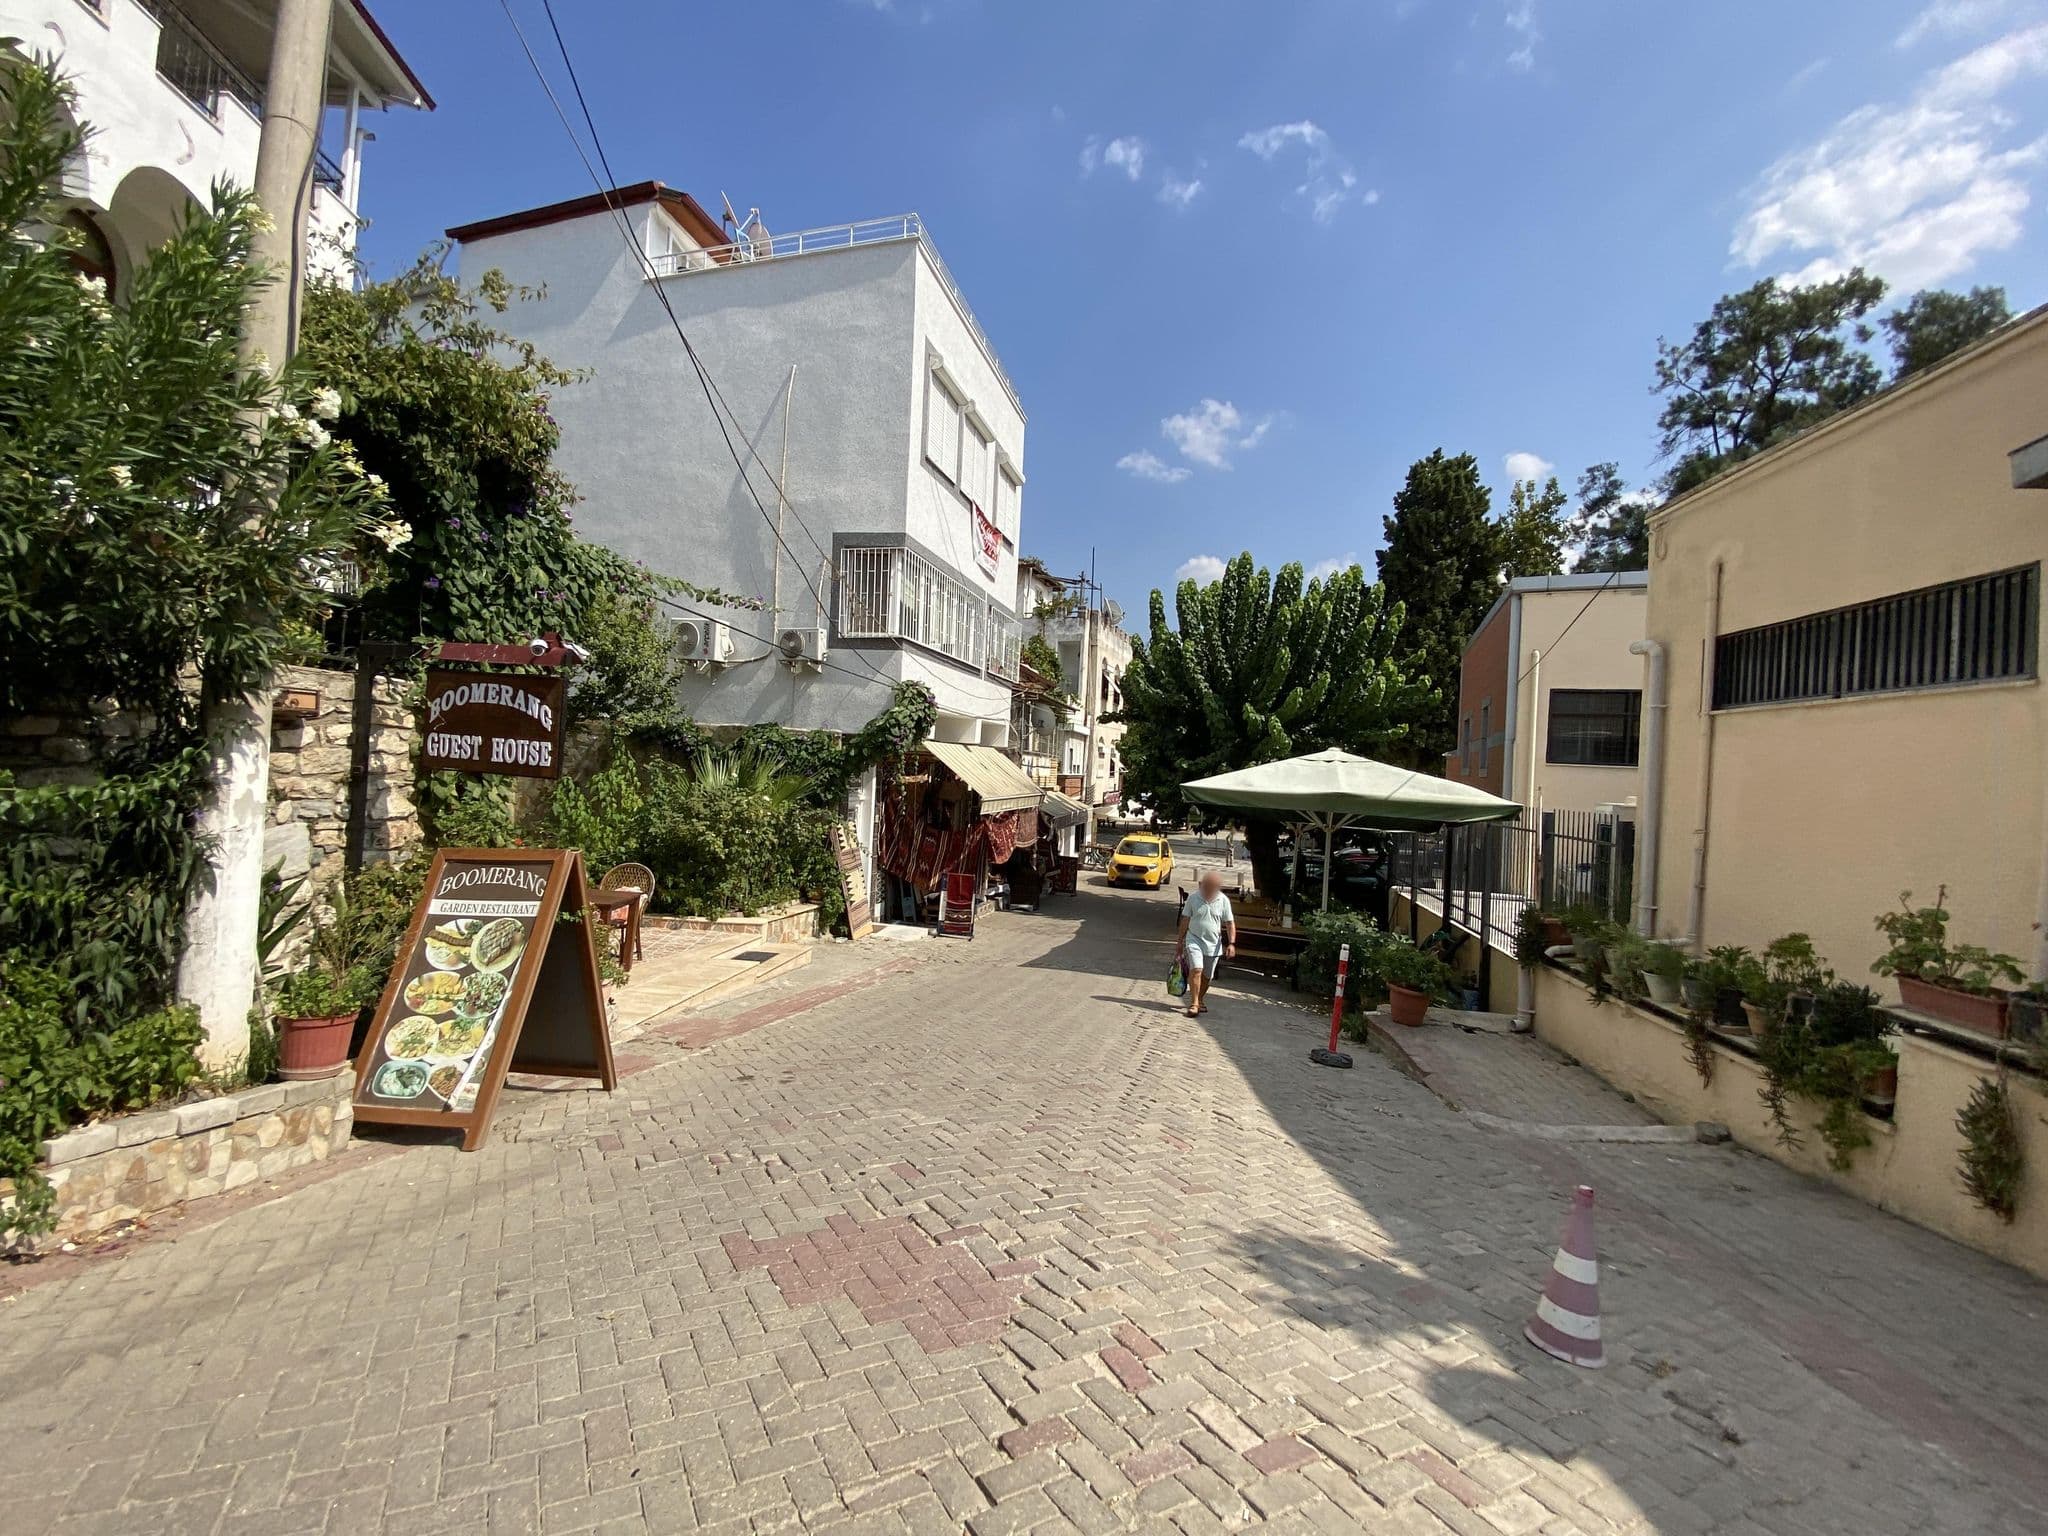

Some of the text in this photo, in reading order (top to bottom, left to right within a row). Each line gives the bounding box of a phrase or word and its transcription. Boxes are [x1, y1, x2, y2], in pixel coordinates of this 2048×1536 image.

[429, 682, 552, 732] BOOMERANG
[427, 732, 552, 767] GUEST HOUSE
[438, 867, 547, 897] BOOMERANG
[440, 902, 537, 915] GARDEN RESTAURANT
